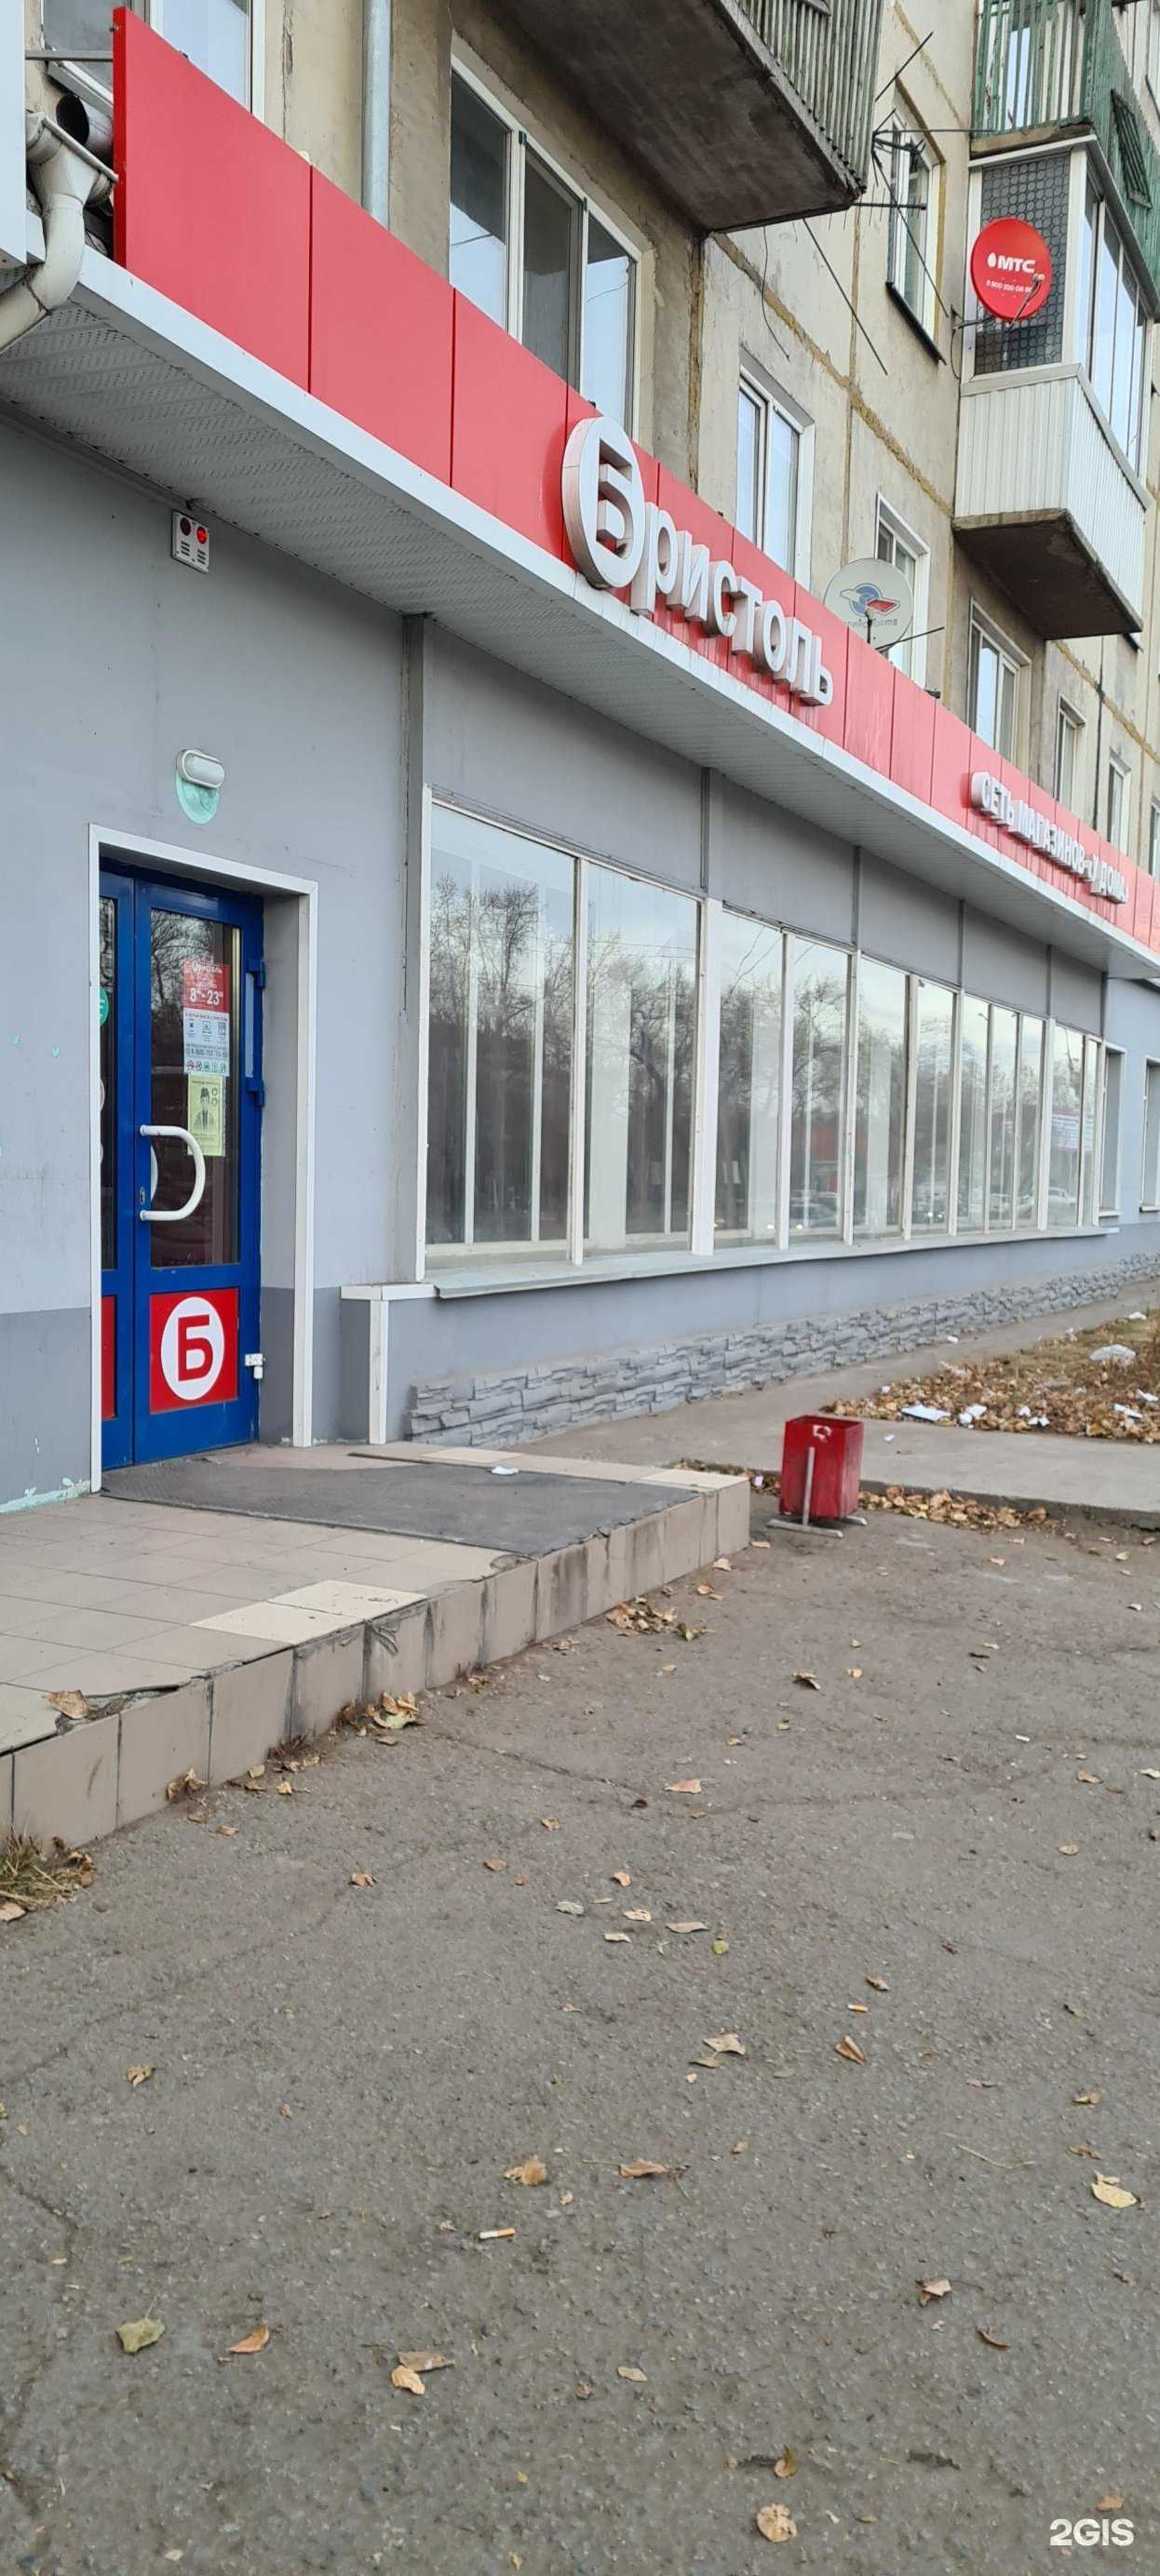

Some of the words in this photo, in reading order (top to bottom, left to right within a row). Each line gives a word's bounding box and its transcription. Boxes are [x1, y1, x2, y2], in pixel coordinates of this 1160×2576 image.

[997, 254, 1036, 274] МТС
[562, 415, 833, 705] Бристоль
[971, 771, 1014, 827] СЕТЬ
[1009, 798, 1086, 877] МАГАЗИНОВ
[1093, 859, 1129, 903] ДОМА
[178, 1313, 213, 1382] Б
